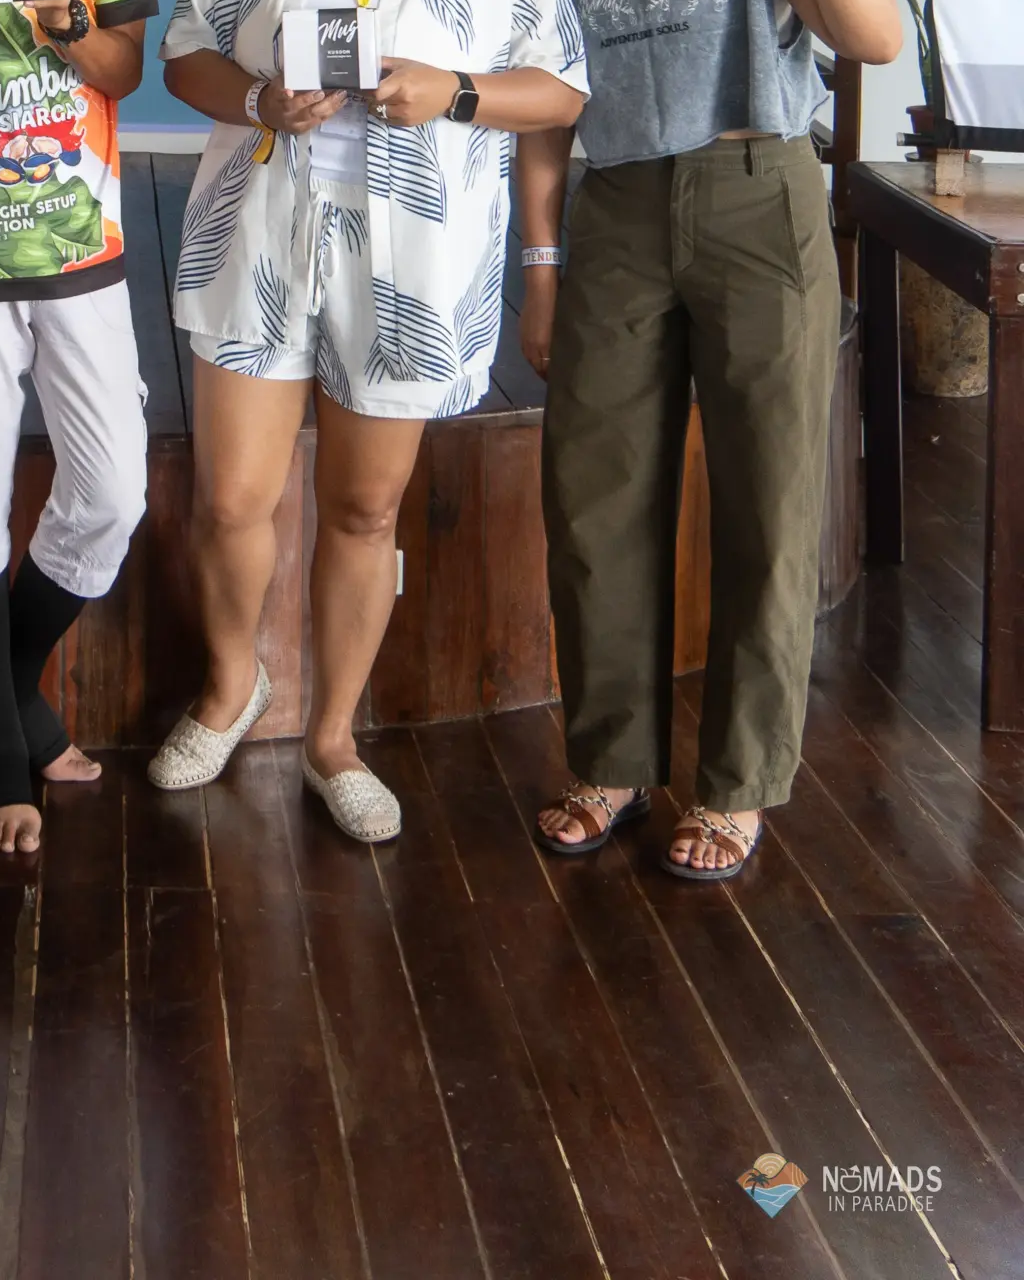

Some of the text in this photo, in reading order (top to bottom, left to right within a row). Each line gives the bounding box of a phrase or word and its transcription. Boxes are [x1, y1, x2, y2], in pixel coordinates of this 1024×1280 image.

[318, 18, 359, 46] Mug
[600, 21, 690, 50] ADVENTURE SOULS
[36, 193, 77, 215] SETUP
